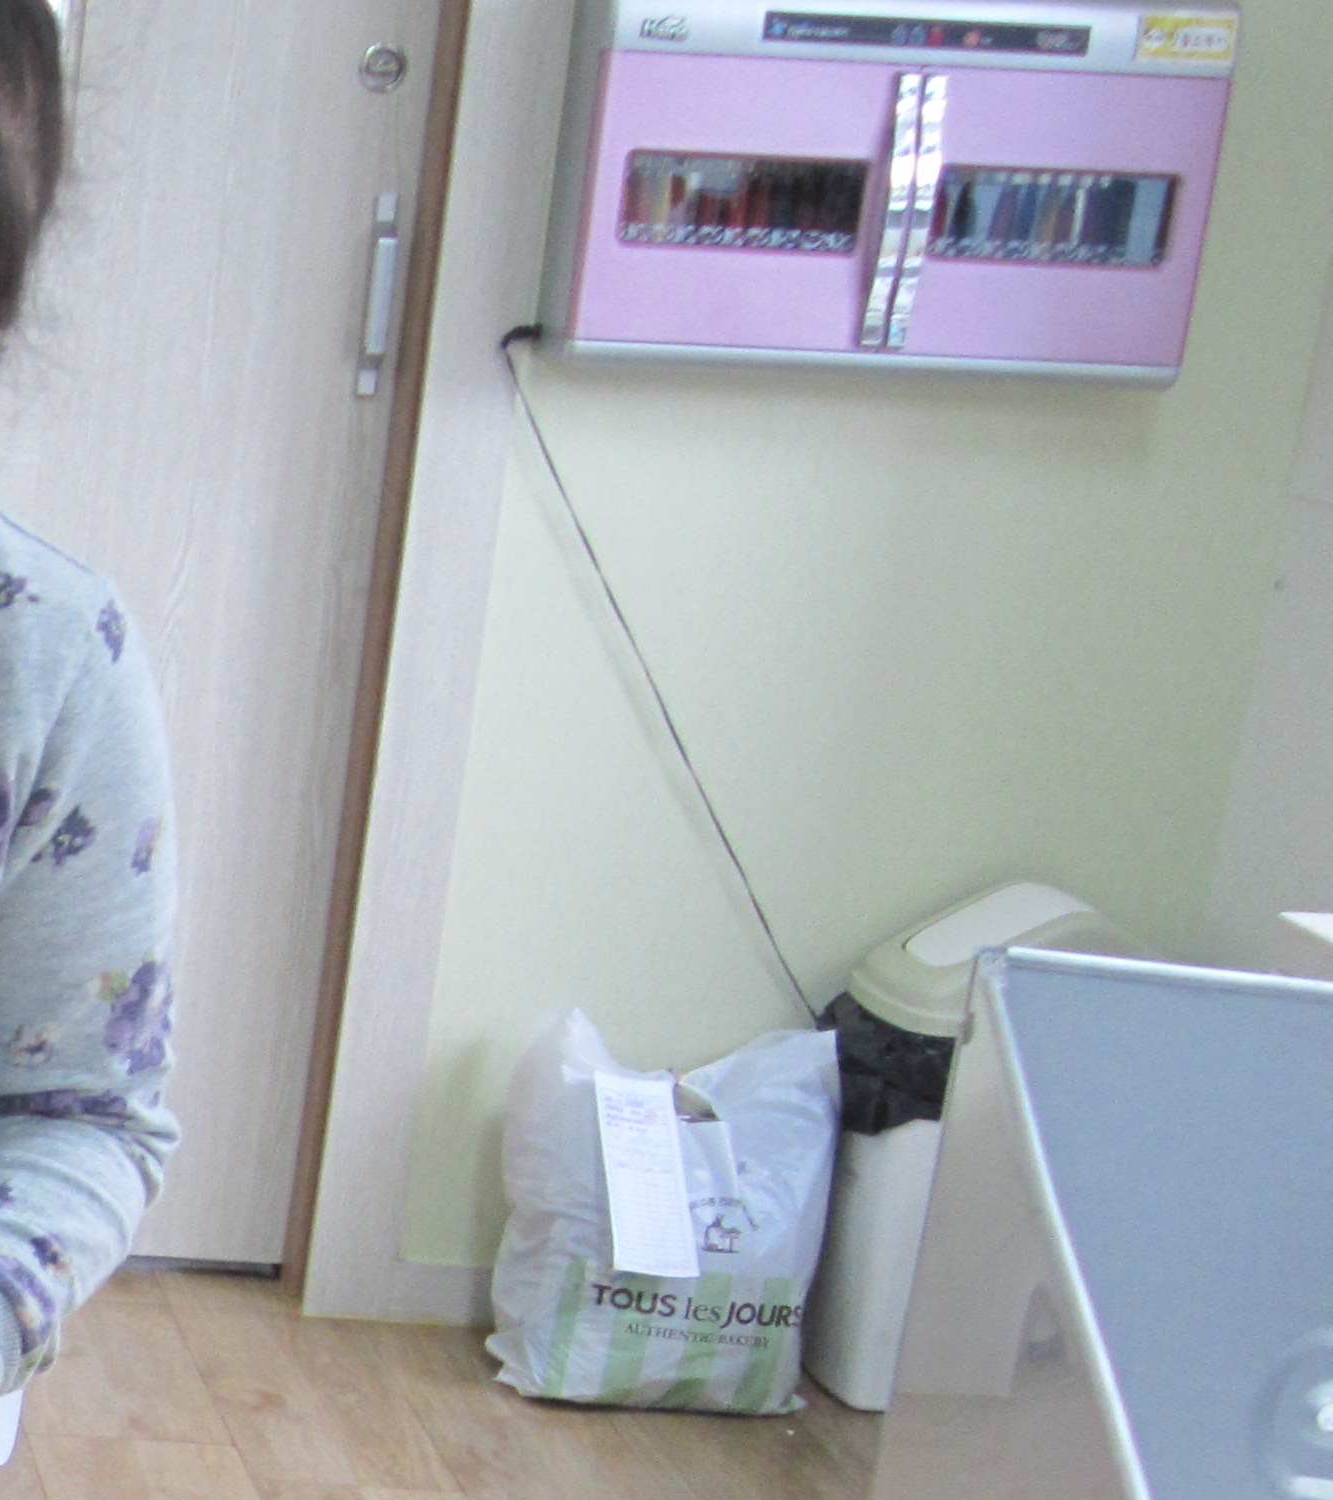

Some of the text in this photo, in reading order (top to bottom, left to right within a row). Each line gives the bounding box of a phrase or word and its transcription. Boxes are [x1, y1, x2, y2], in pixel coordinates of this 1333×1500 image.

[592, 1284, 677, 1317] TOUS
[684, 1297, 721, 1322] les
[717, 1334, 770, 1349] BAKERY
